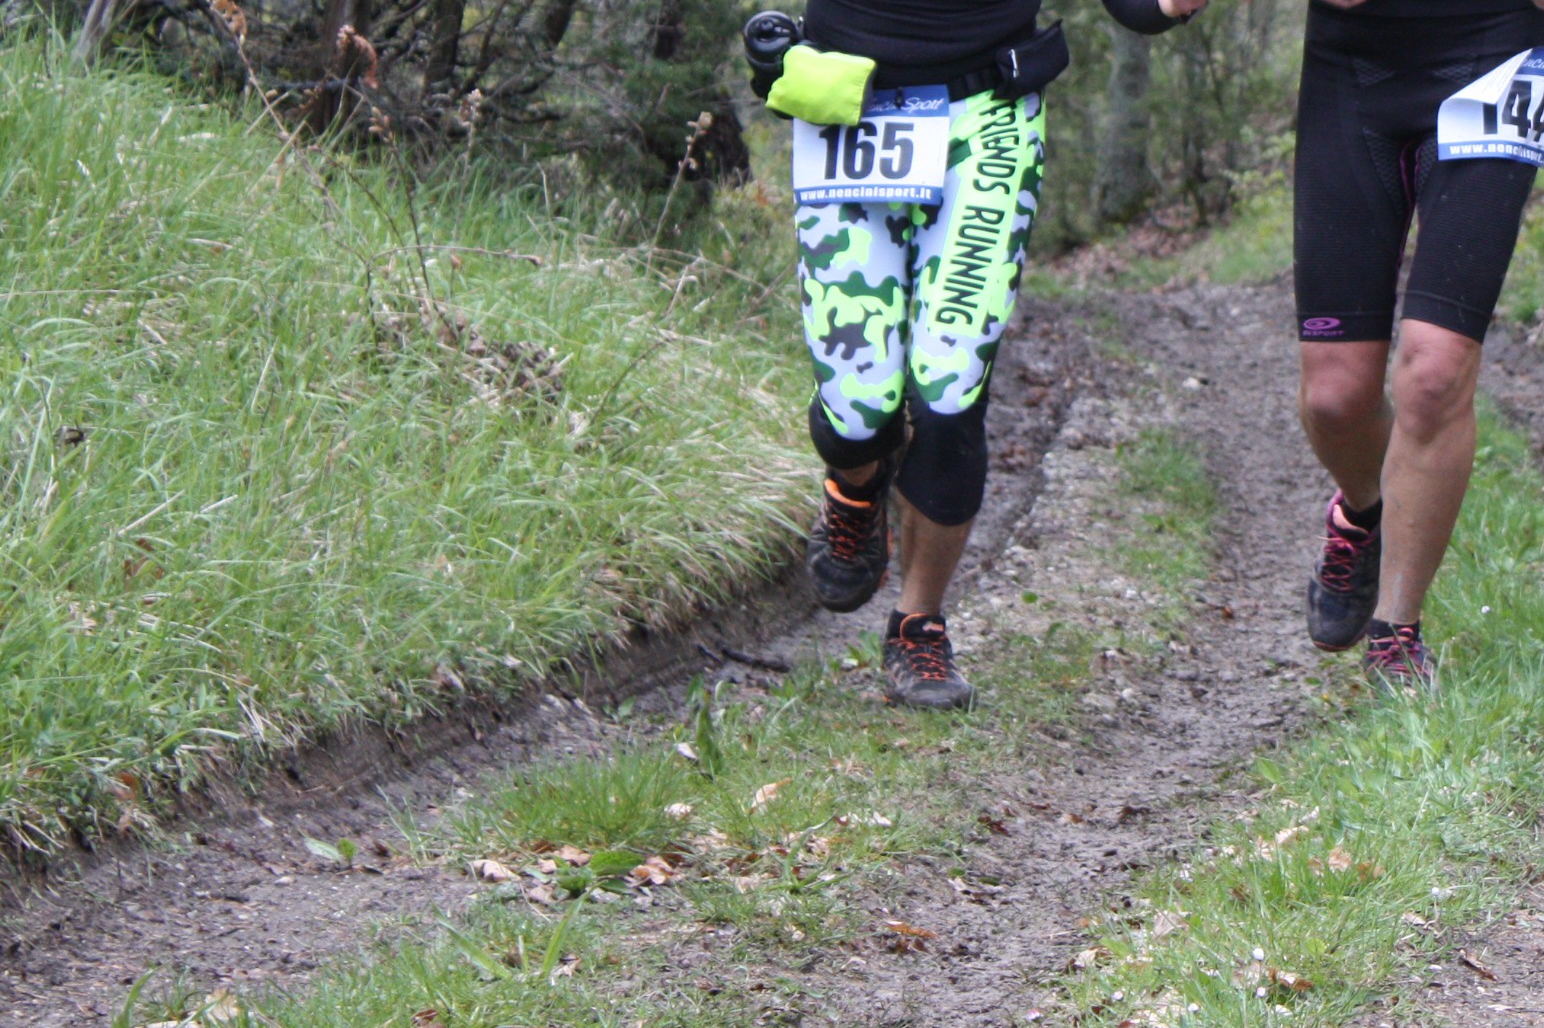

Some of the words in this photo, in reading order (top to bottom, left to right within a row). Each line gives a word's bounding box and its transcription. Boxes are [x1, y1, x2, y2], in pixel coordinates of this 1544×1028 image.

[819, 120, 914, 180] 165
[973, 98, 1020, 196] FRIENDS
[800, 186, 932, 202] www.nencinisport.it
[935, 204, 1006, 326] RUNNING
